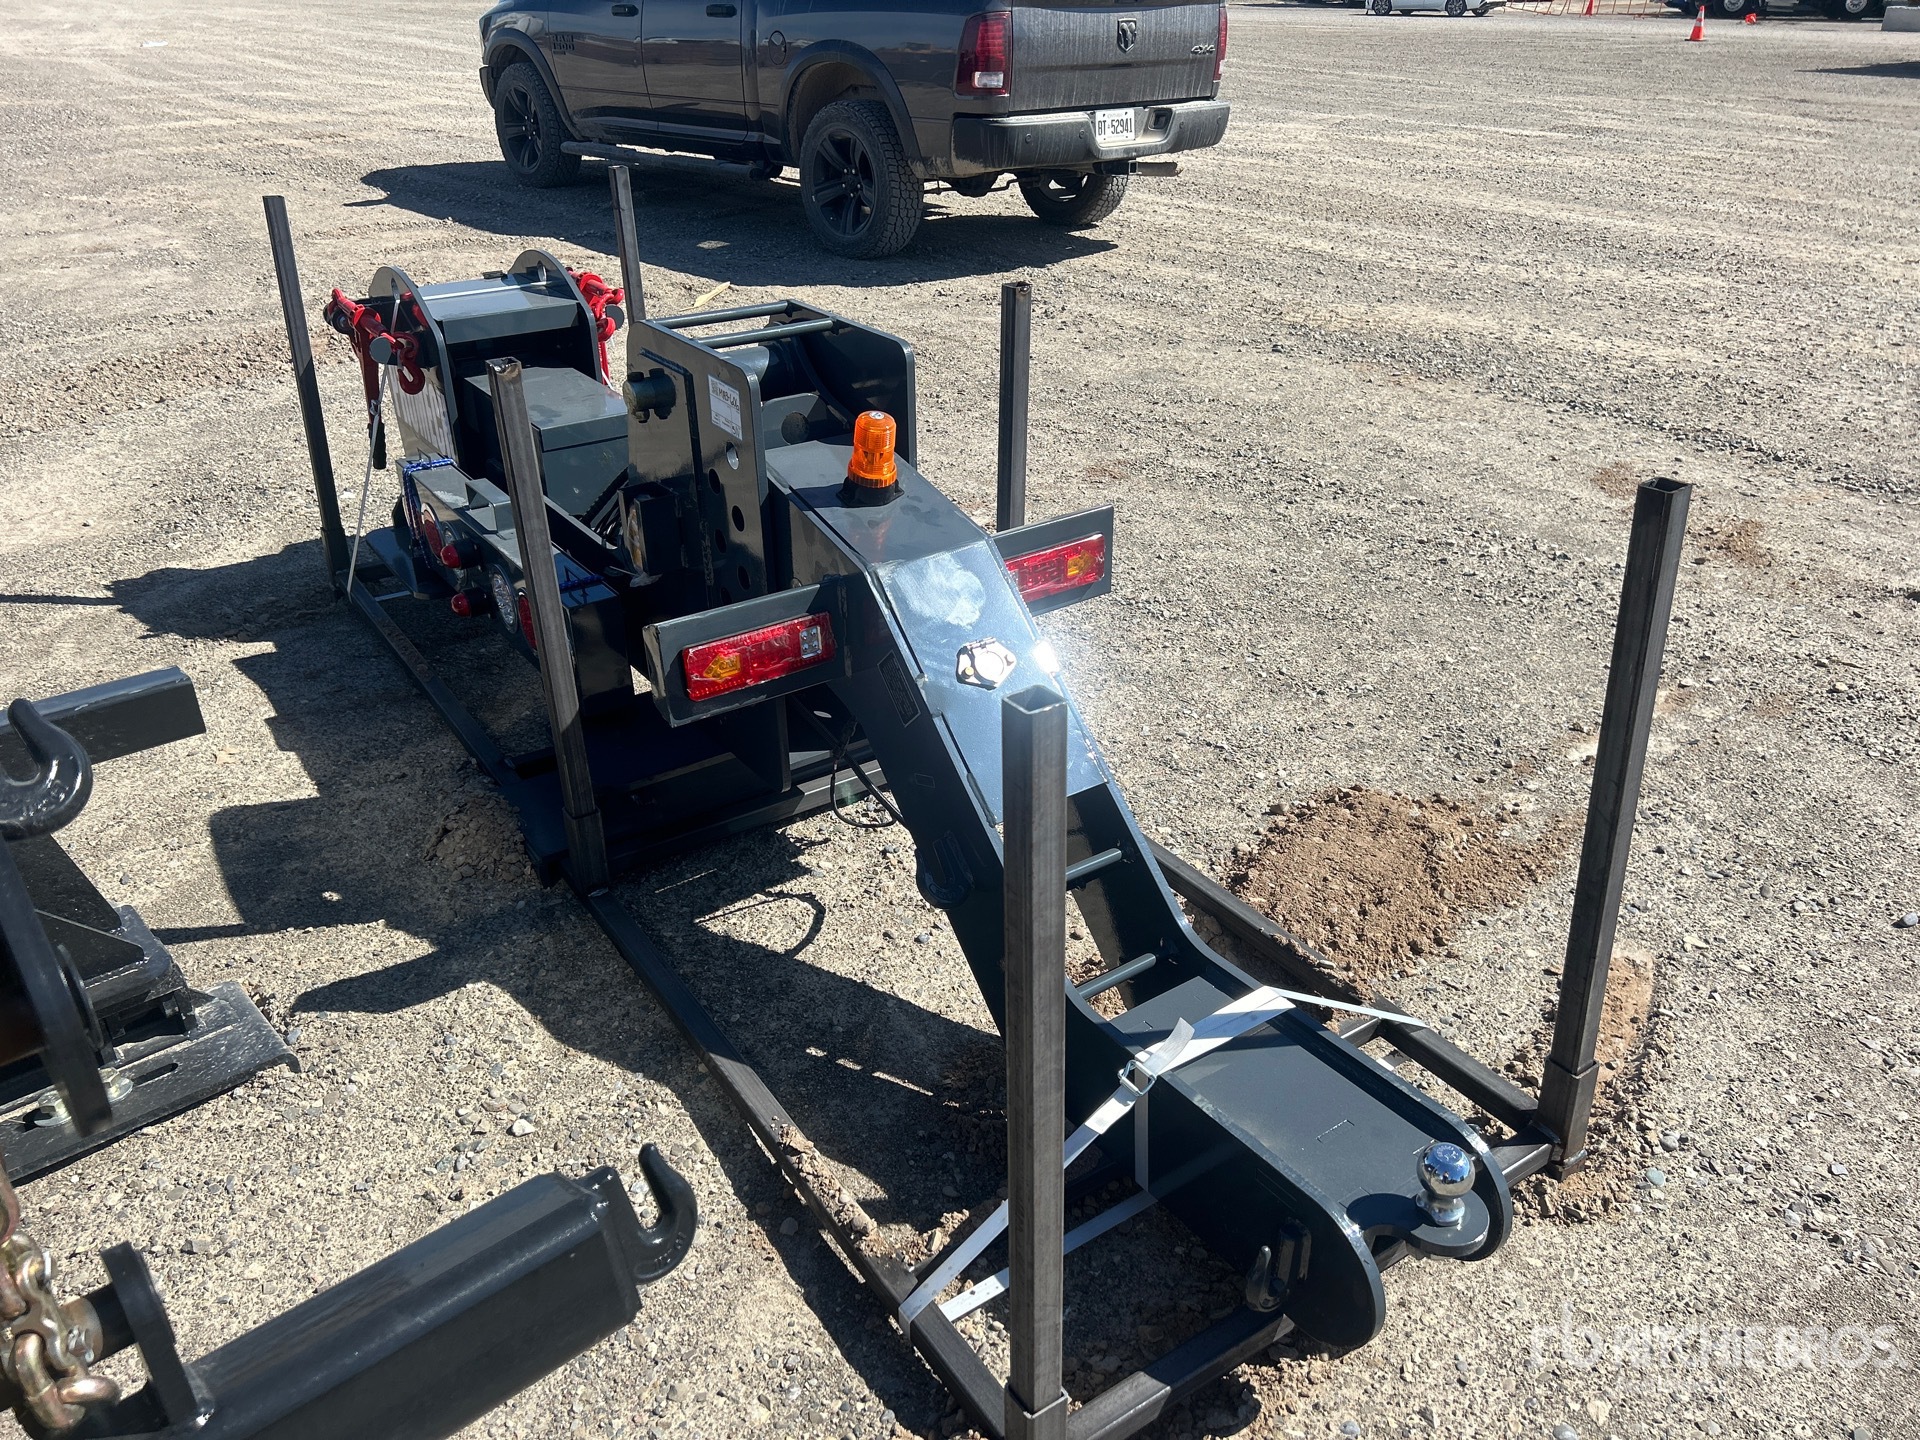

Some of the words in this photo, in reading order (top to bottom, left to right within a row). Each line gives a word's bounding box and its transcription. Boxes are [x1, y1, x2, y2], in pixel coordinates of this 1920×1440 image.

[551, 34, 574, 43] RAM
[1097, 120, 1107, 136] BT
[1110, 118, 1133, 135] 52941
